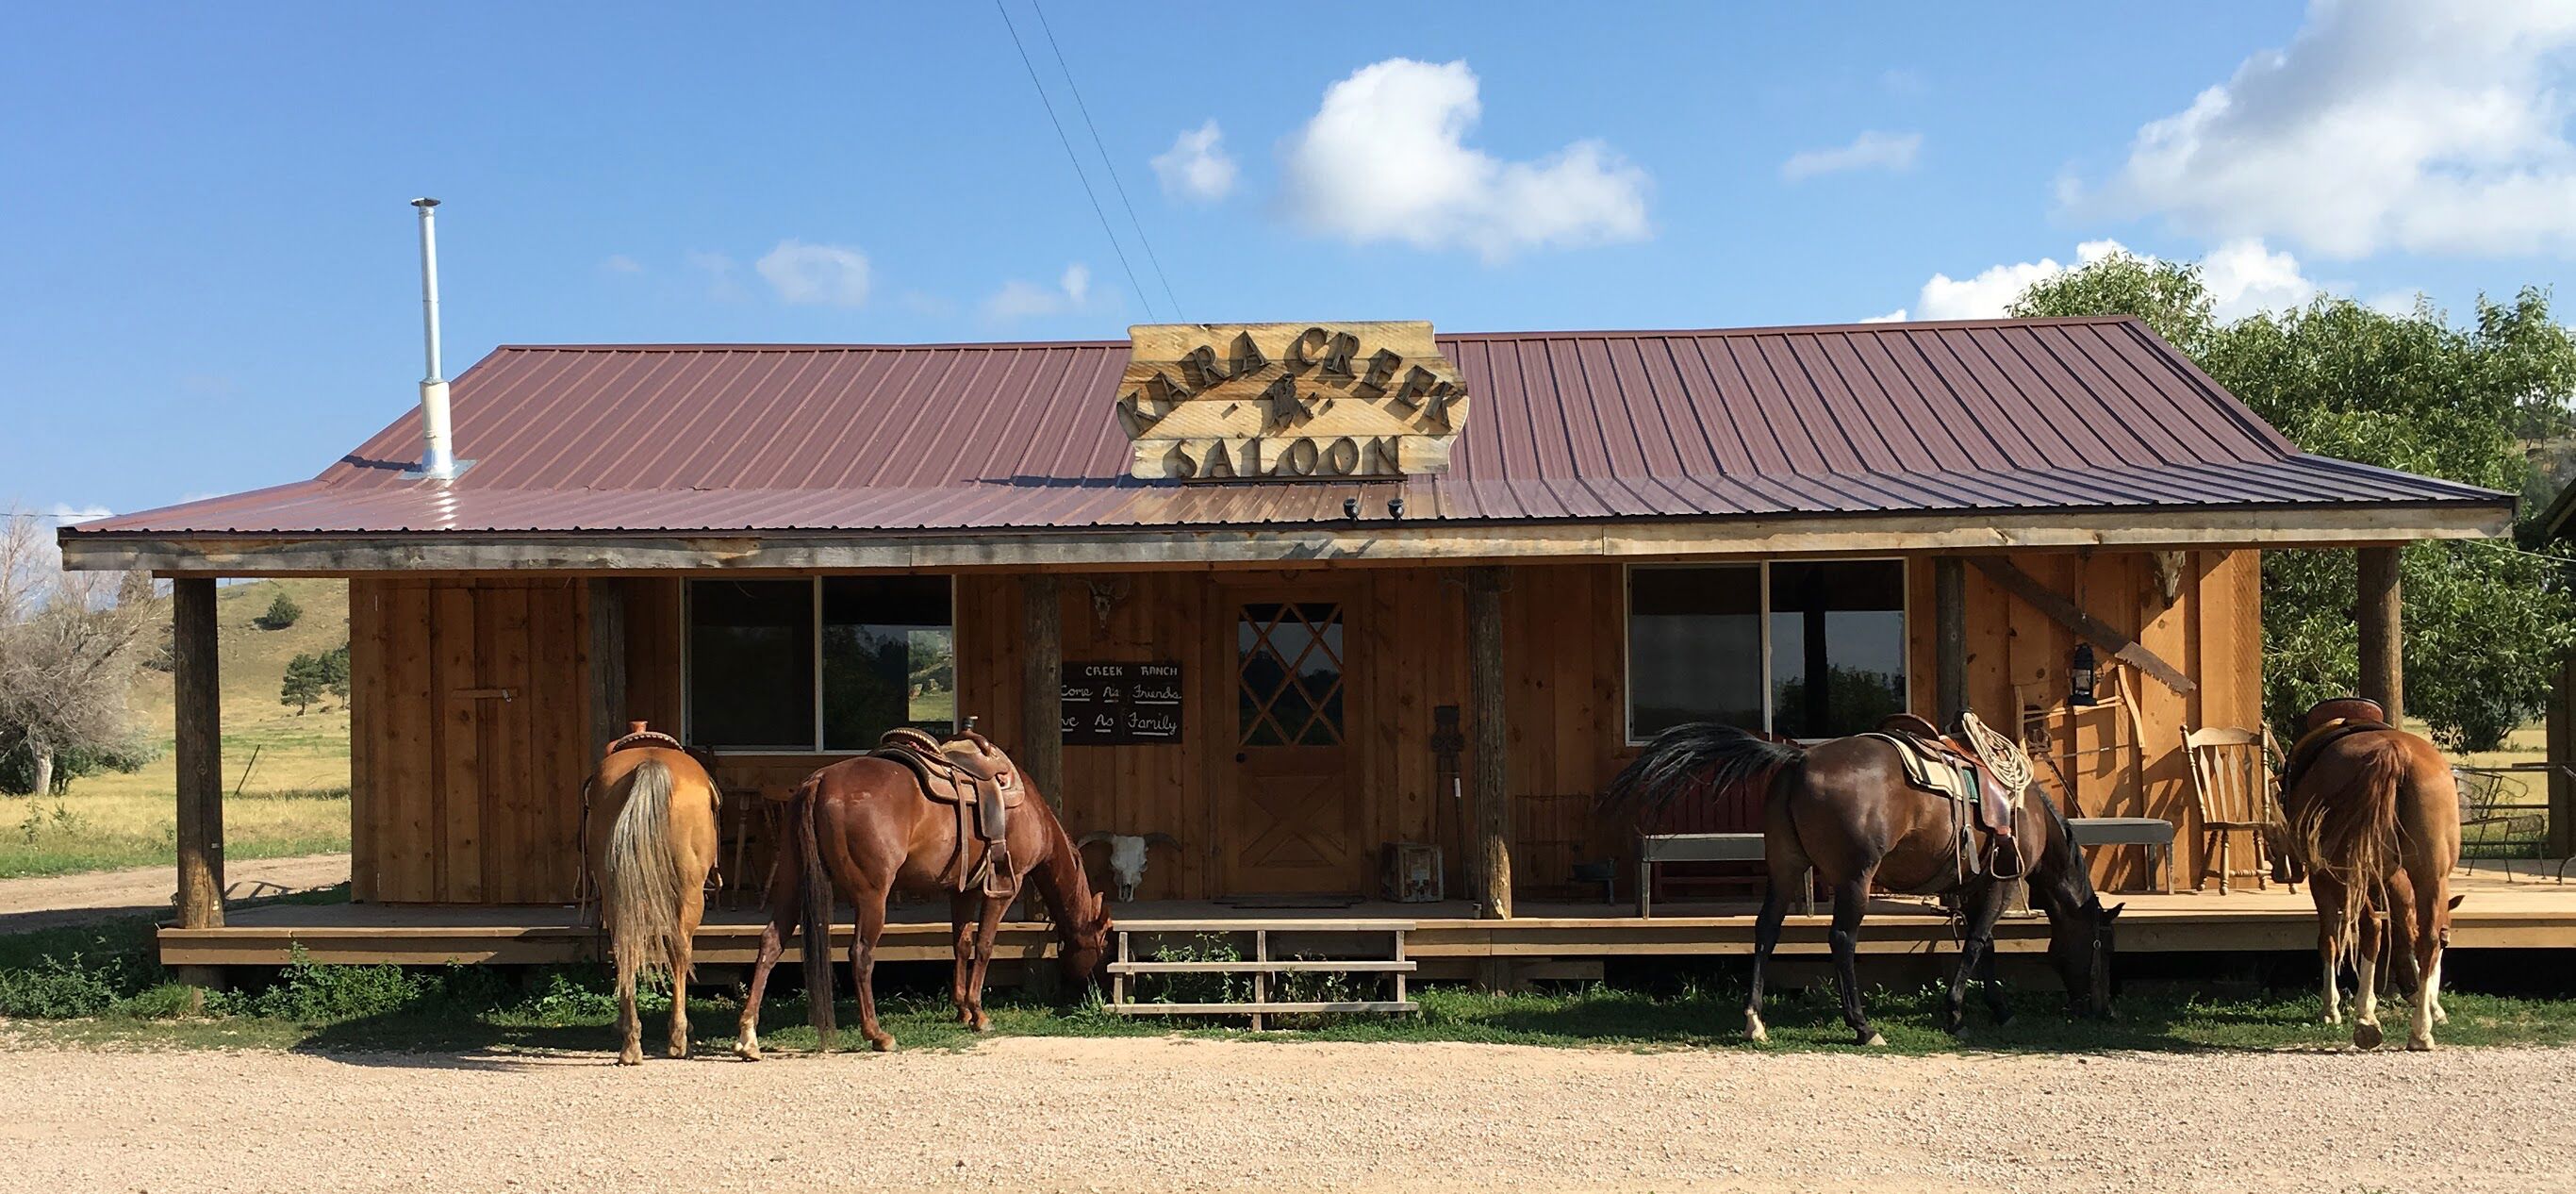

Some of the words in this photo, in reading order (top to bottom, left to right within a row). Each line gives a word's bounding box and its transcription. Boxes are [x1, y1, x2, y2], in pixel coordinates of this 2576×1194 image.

[1116, 330, 1271, 435] KARA
[1296, 327, 1468, 431] CREEK
[1172, 436, 1401, 476] SALOON
[1085, 666, 1123, 676] CREEK
[1140, 666, 1178, 676] RANCH
[1061, 685, 1093, 697] Come
[1102, 686, 1119, 698] As
[1094, 714, 1115, 727] As
[1128, 712, 1178, 736] Family
